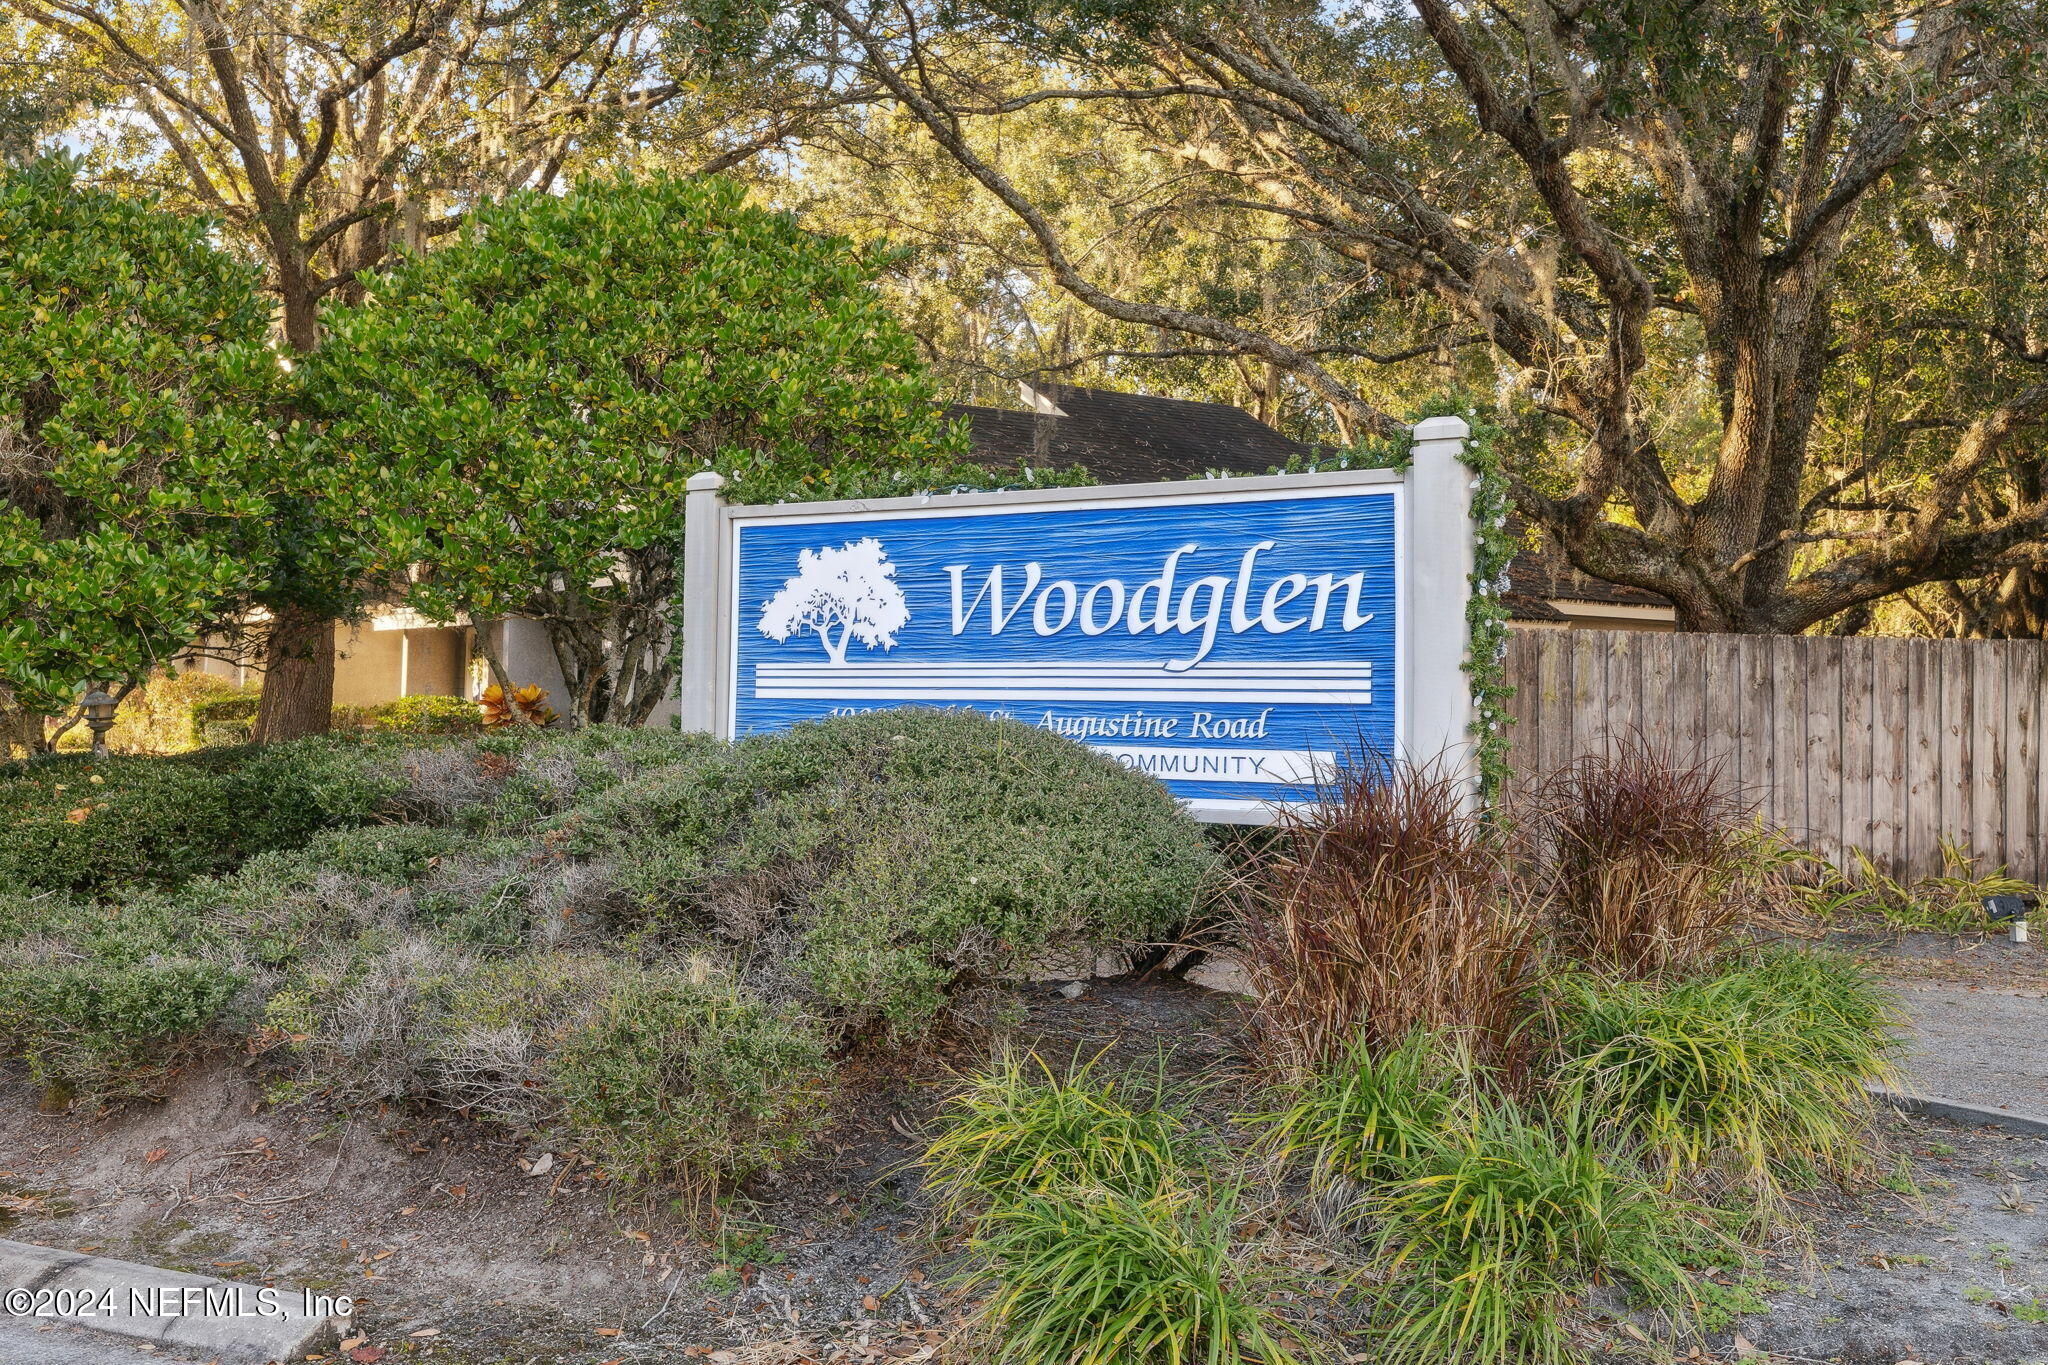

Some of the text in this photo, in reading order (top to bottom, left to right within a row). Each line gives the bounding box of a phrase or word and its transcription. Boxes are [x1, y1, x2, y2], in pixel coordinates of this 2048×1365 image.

[942, 540, 1374, 672] Woodglen
[1036, 709, 1178, 744] Augustine
[1189, 707, 1275, 739] Road
[1101, 753, 1266, 775] OMMUNITY
